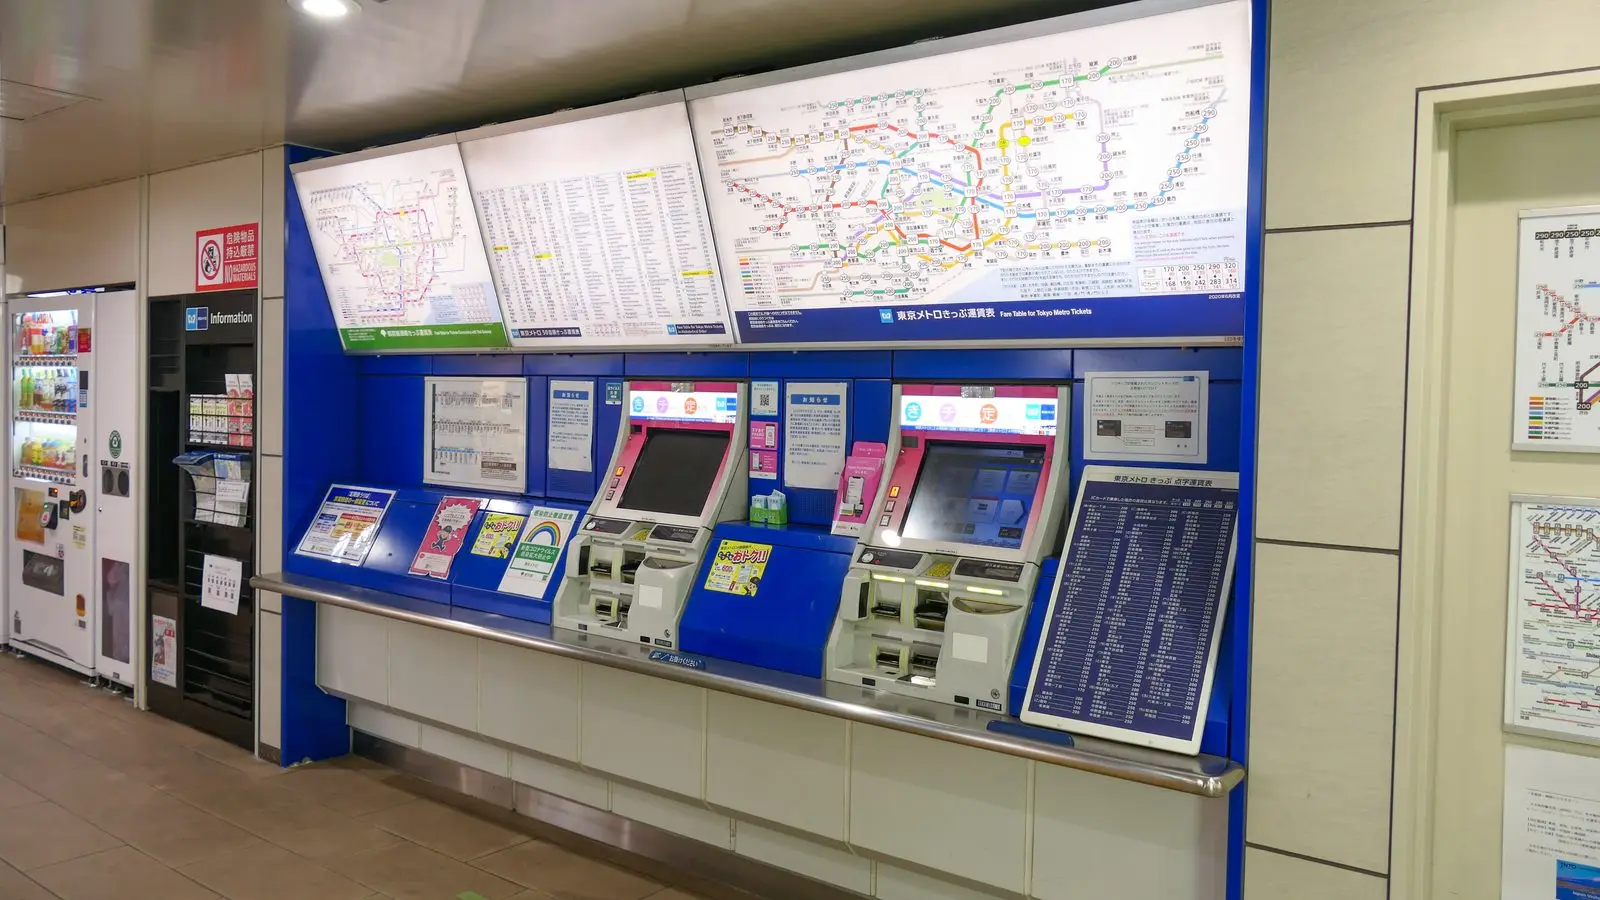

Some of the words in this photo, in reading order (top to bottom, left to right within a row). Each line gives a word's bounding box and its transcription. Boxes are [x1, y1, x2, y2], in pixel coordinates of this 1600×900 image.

[226, 230, 254, 244] 危険物品
[226, 244, 254, 259] 持込厳禁
[225, 264, 232, 283] NO
[232, 262, 256, 272] HAZARDOUS
[232, 272, 256, 282] MATERIALS
[210, 311, 252, 324] Information
[896, 308, 996, 320] 東京メトロきっぷ運賃表
[520, 551, 550, 560] 感染拡大防止中
[521, 544, 556, 555] 新型コロナウイルス
